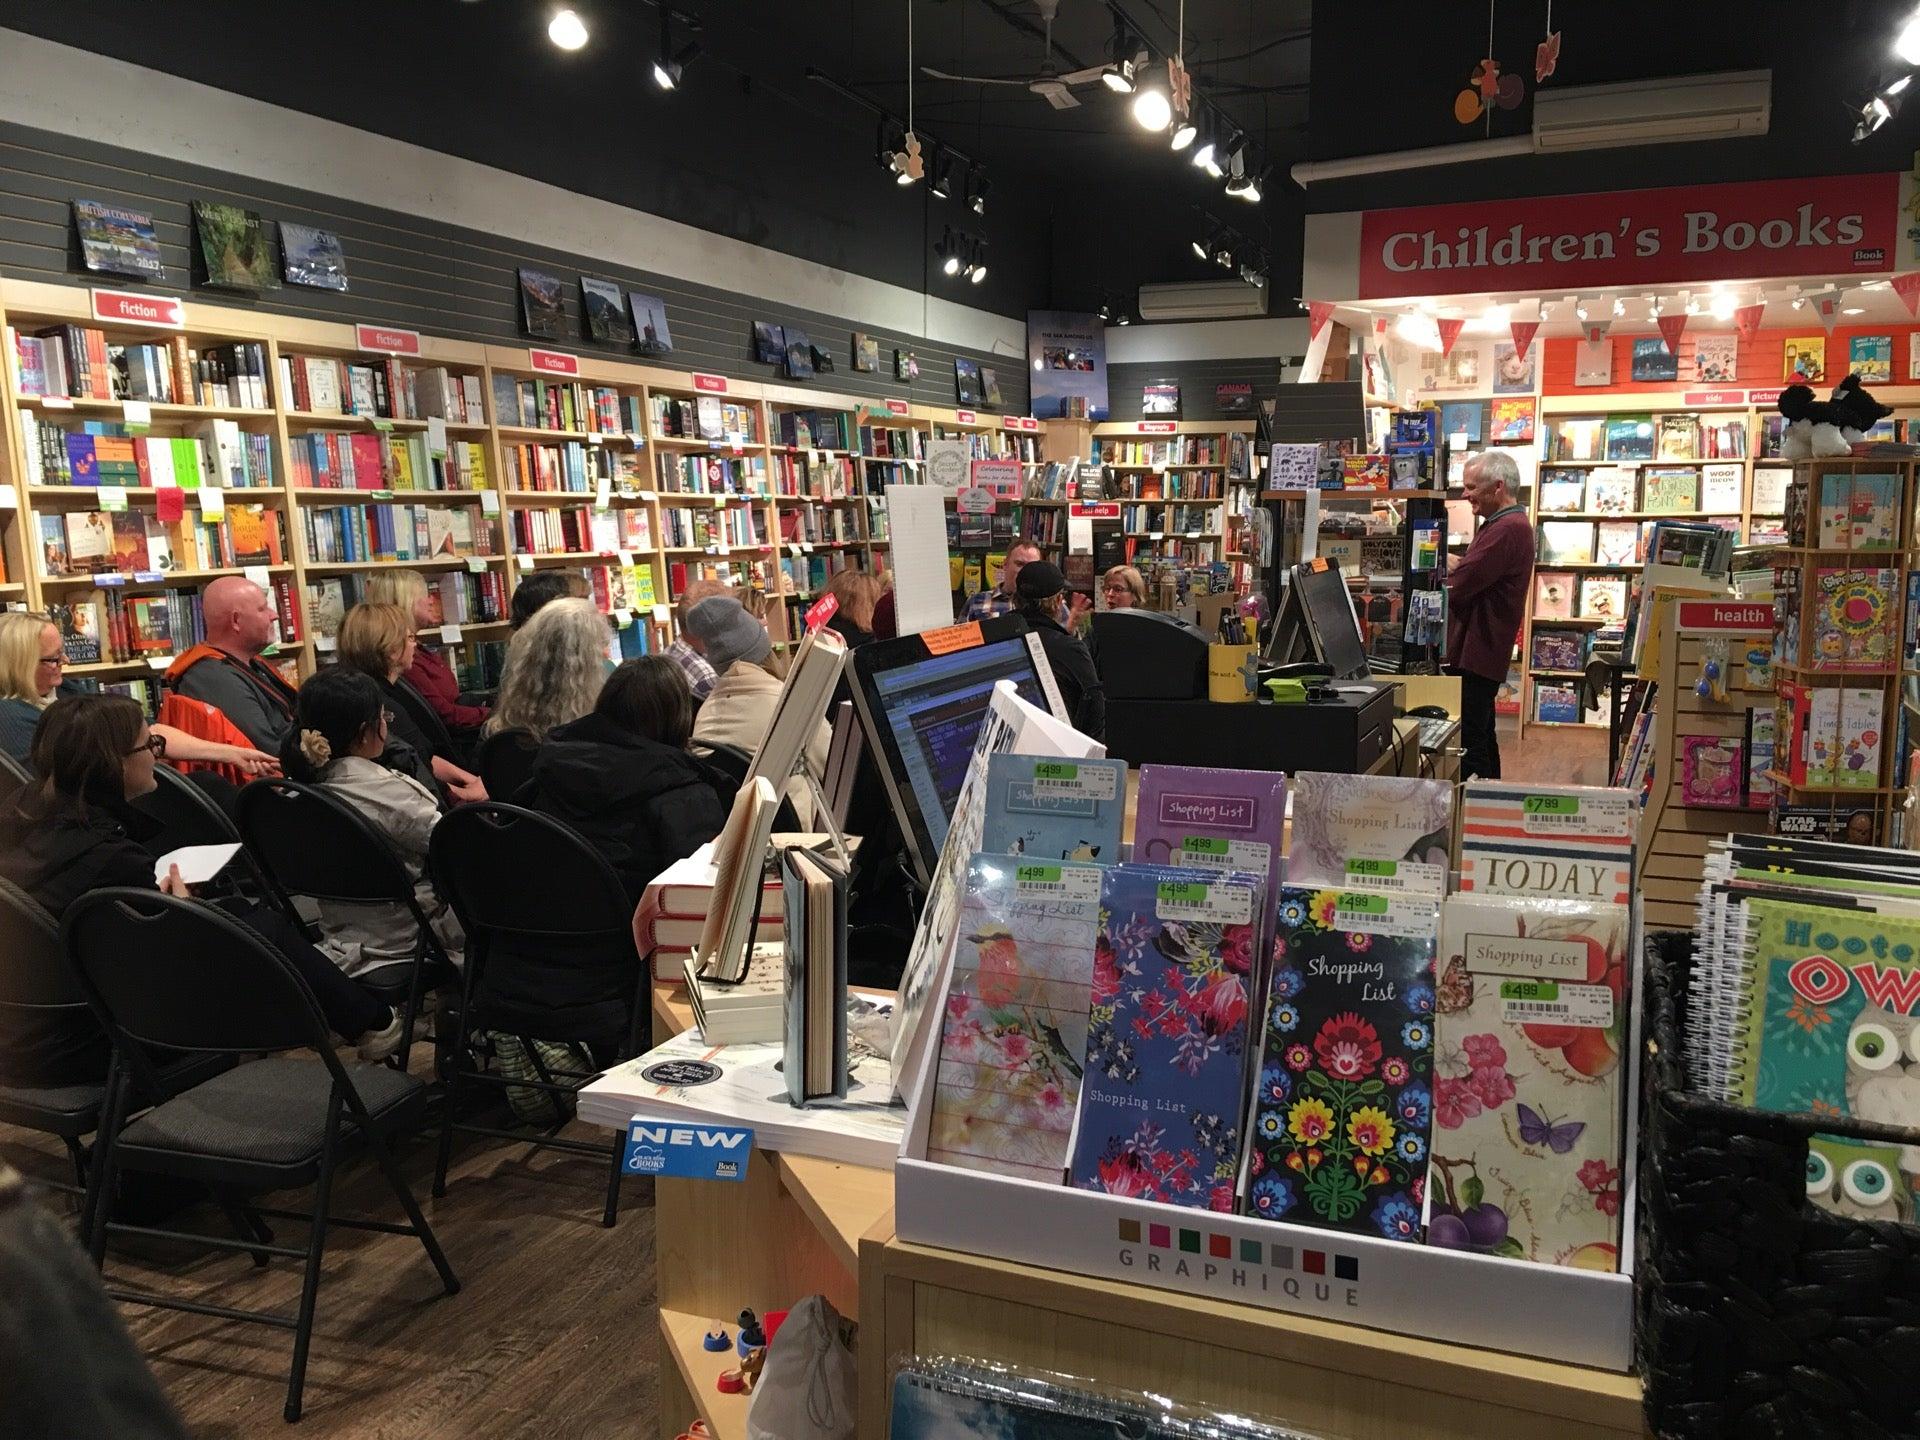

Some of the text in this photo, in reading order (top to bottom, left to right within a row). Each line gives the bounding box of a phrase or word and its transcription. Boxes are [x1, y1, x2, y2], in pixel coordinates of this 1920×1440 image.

[79, 203, 151, 225] BRITISH COLUMBIA
[1382, 203, 1864, 273] Children’s Books
[1855, 249, 1883, 260] Book
[135, 257, 160, 271] 2017
[119, 301, 157, 318] fiction
[375, 332, 403, 347] fiction
[544, 357, 566, 369] fiction
[702, 378, 720, 388] fiction
[1216, 384, 1252, 394] CANADA
[1705, 395, 1722, 403] kids
[1144, 423, 1170, 432] biography
[1094, 506, 1109, 515] help
[1714, 608, 1765, 623] health
[1169, 803, 1244, 821] Shopping List
[1328, 808, 1389, 830] Shopping
[1780, 821, 1817, 832] WARS
[1785, 816, 1815, 825] STAR
[1480, 857, 1608, 896] TODAY
[1049, 900, 1085, 916] List
[1476, 944, 1579, 969] Shopping List
[1307, 954, 1384, 985] Shopping
[1361, 981, 1397, 1001] List
[1090, 1089, 1187, 1114] Shopping List
[631, 1126, 747, 1149] NEW
[635, 1159, 665, 1168] BOOKS
[717, 1161, 737, 1171] Book
[1119, 1249, 1358, 1307] GRAPHIQUE
